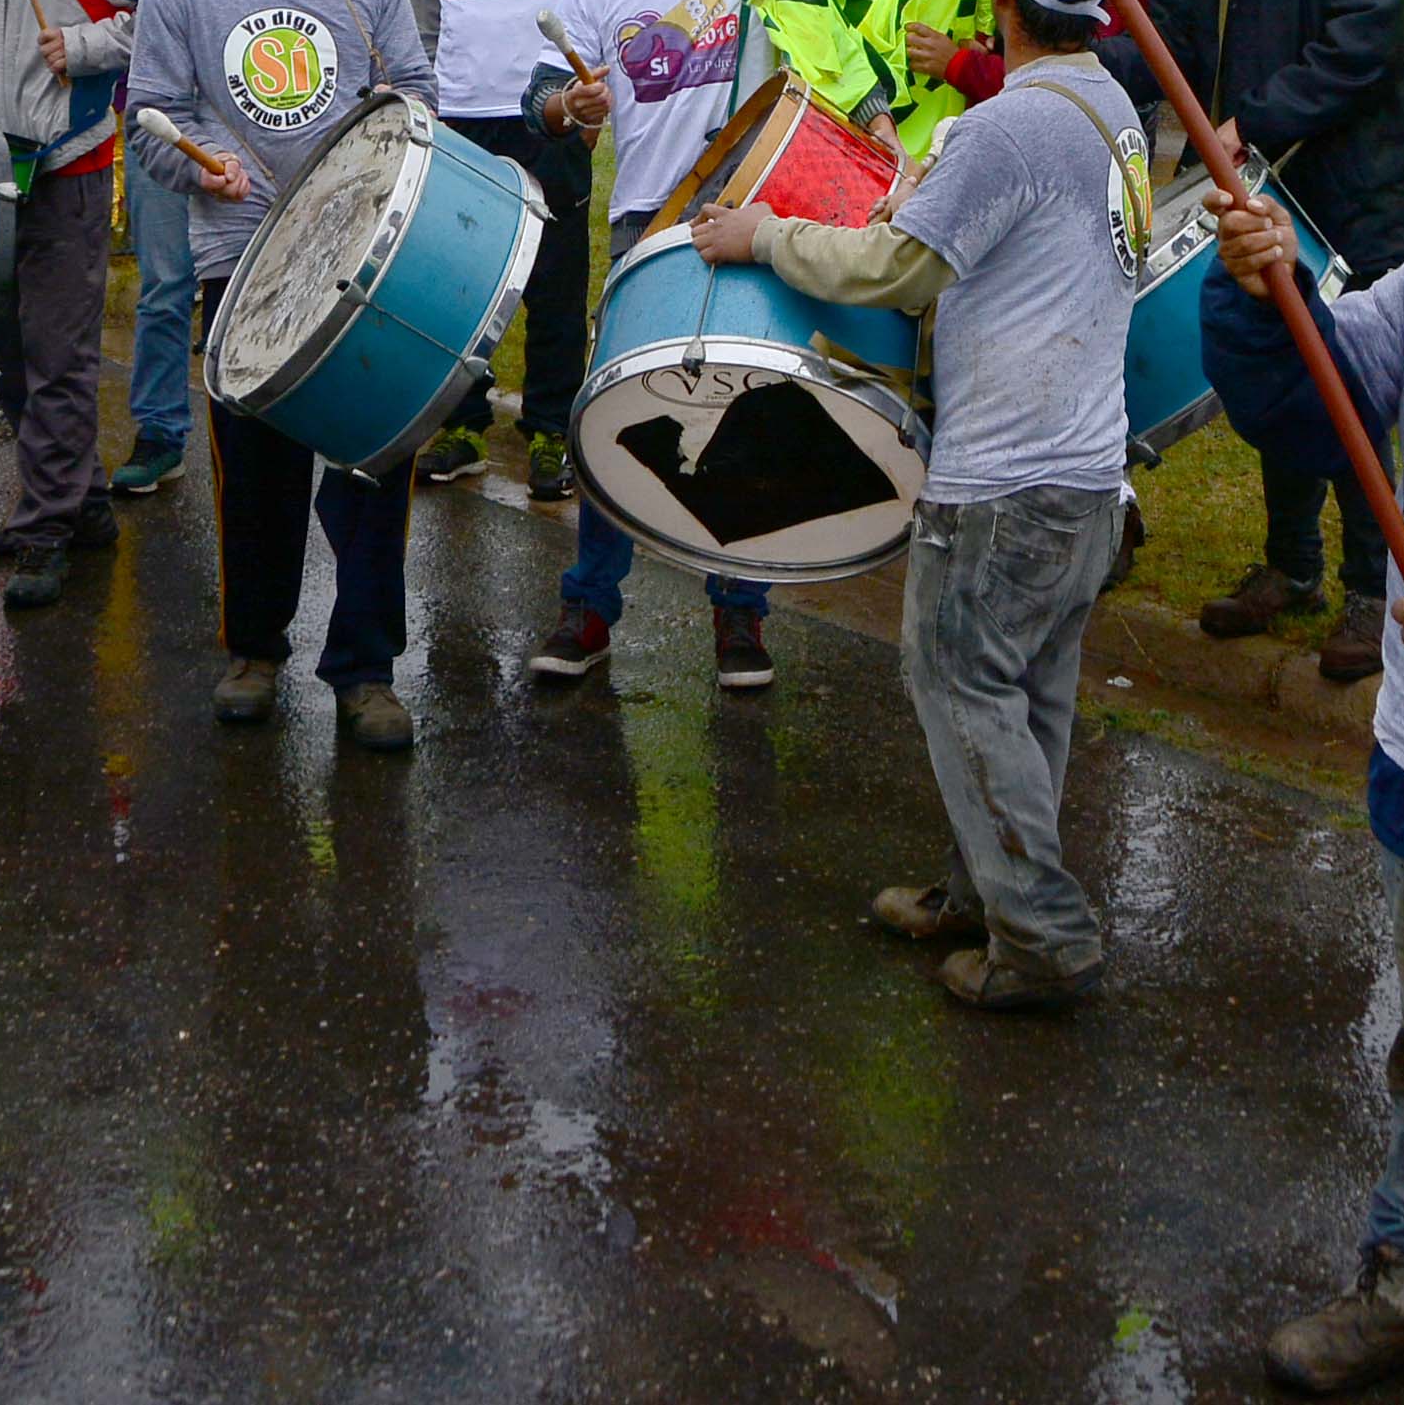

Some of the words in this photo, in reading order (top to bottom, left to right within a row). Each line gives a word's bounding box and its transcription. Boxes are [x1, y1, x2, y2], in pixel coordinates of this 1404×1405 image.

[240, 17, 266, 36] Yo
[272, 11, 317, 36] digo
[697, 19, 736, 48] 2016
[250, 36, 311, 96] Sí
[650, 56, 670, 77] Sí
[228, 74, 240, 89] al
[235, 86, 282, 127] Parque
[285, 111, 302, 127] La
[300, 67, 335, 120] Pedrera
